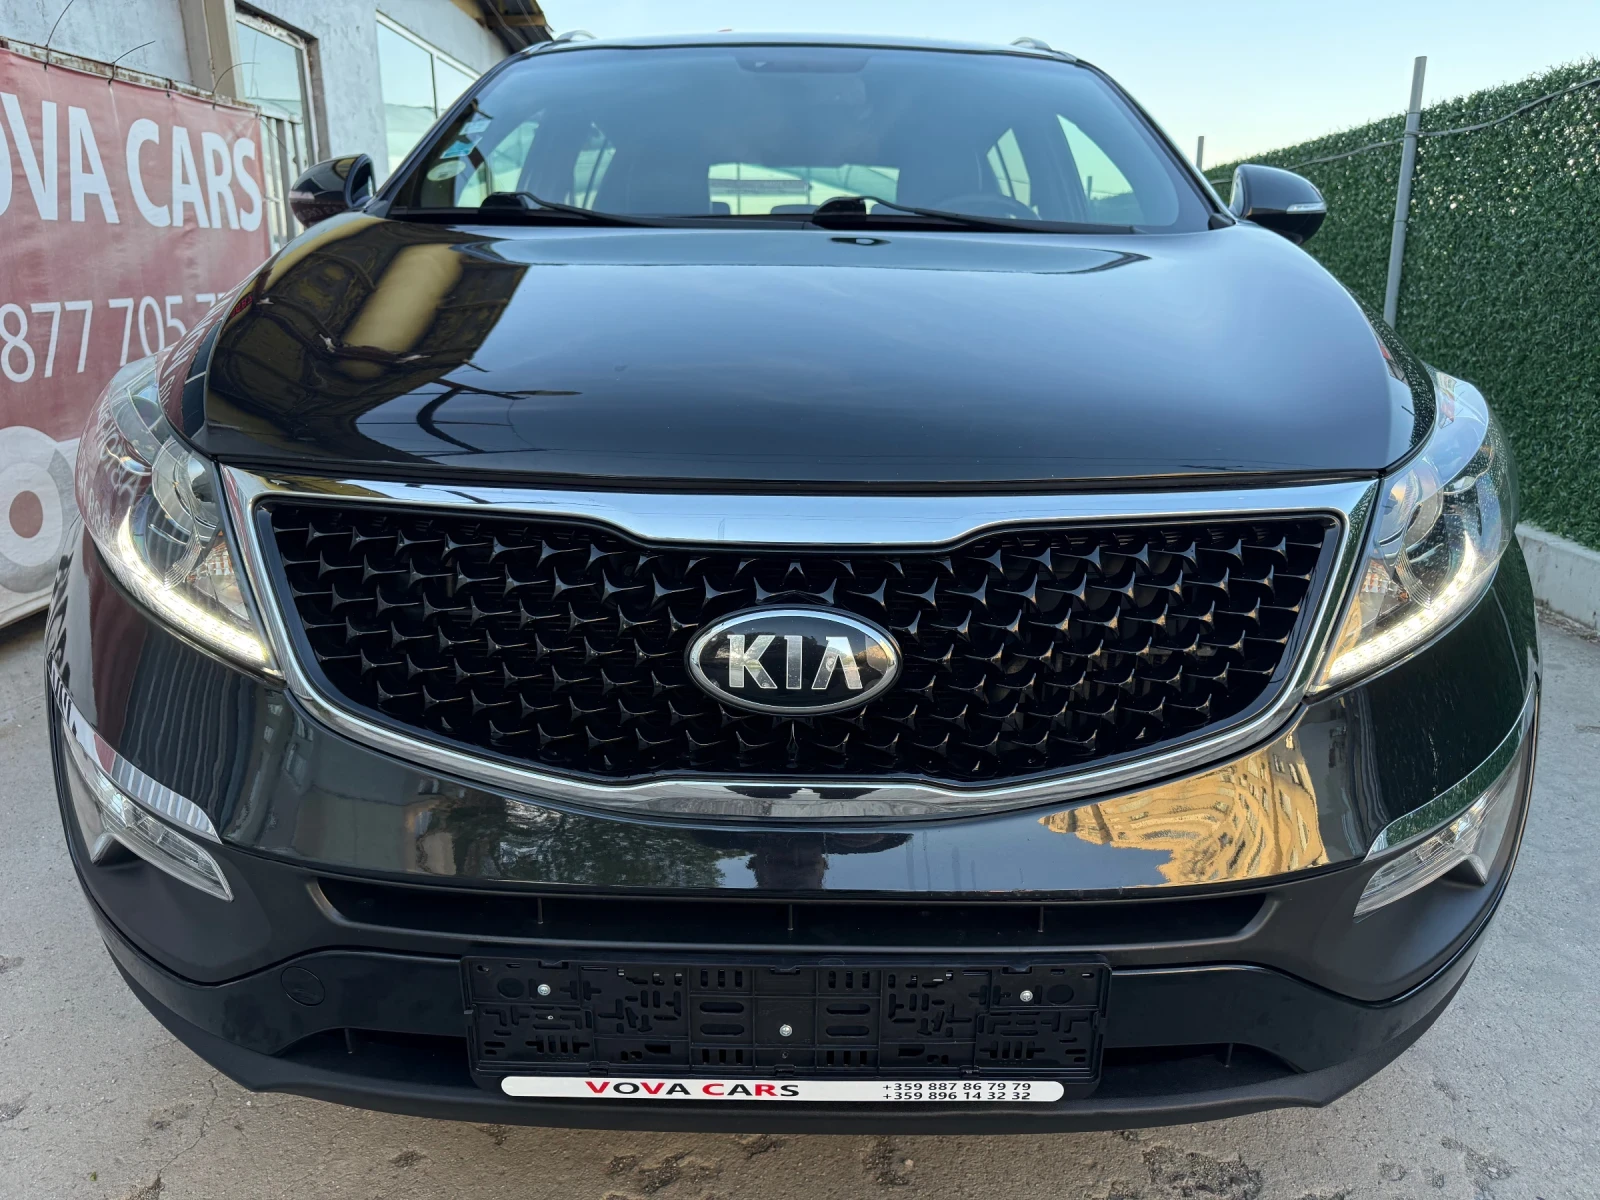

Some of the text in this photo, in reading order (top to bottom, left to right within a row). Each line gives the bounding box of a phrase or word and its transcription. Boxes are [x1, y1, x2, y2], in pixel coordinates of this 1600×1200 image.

[0, 92, 263, 232] VA CARS
[0, 300, 93, 383] 877
[727, 634, 863, 690] KIA
[585, 1081, 799, 1097] VOVA CARS
[883, 1083, 1031, 1091] +359 887 86 79 79
[883, 1092, 1031, 1100] +359 896 14 32 32
